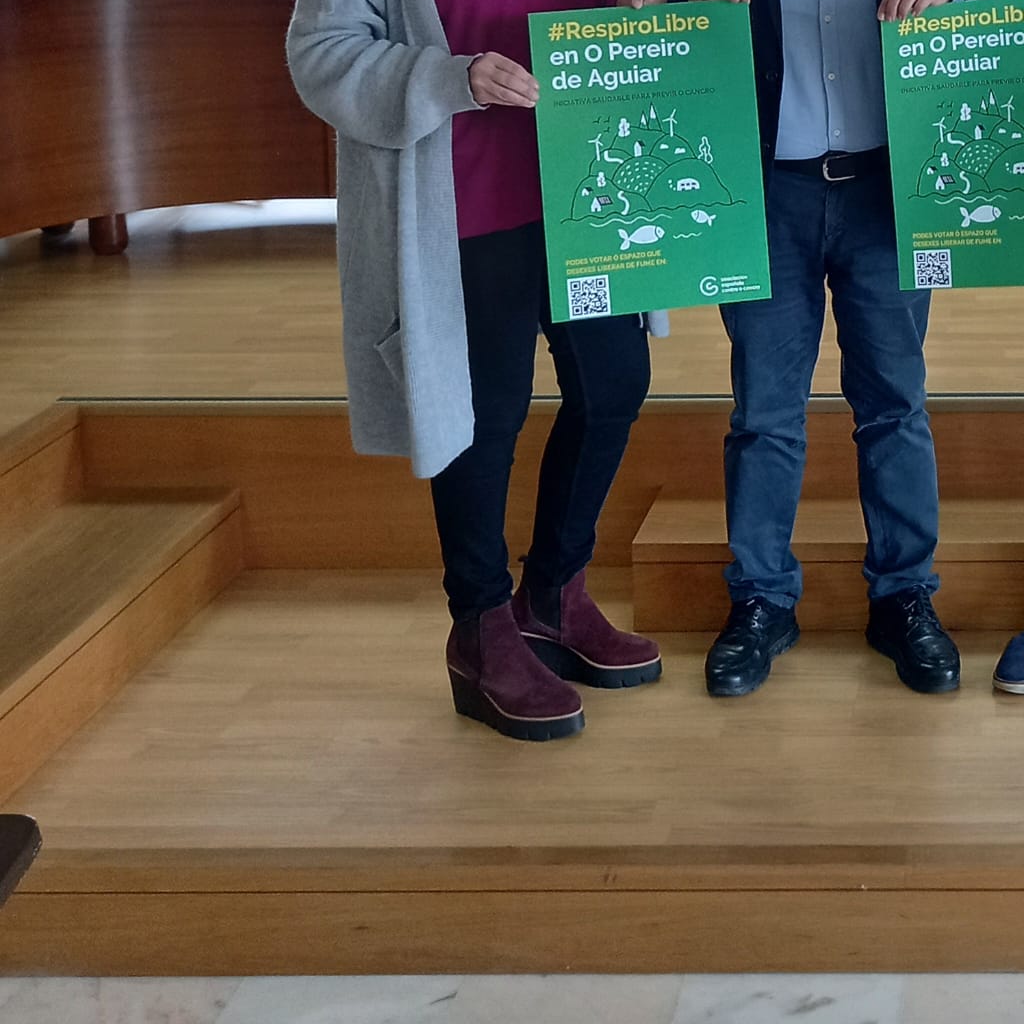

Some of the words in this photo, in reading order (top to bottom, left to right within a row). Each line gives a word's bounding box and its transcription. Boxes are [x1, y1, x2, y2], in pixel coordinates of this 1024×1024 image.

[548, 14, 709, 41] #RespiroLibre
[550, 49, 579, 66] en
[584, 44, 602, 63] O
[609, 39, 690, 61] Pereiro
[899, 43, 924, 57] en
[930, 36, 946, 53] O
[552, 71, 581, 91] de
[588, 65, 662, 91] Aguiar
[900, 61, 927, 79] de
[932, 54, 1000, 77] Aguiar
